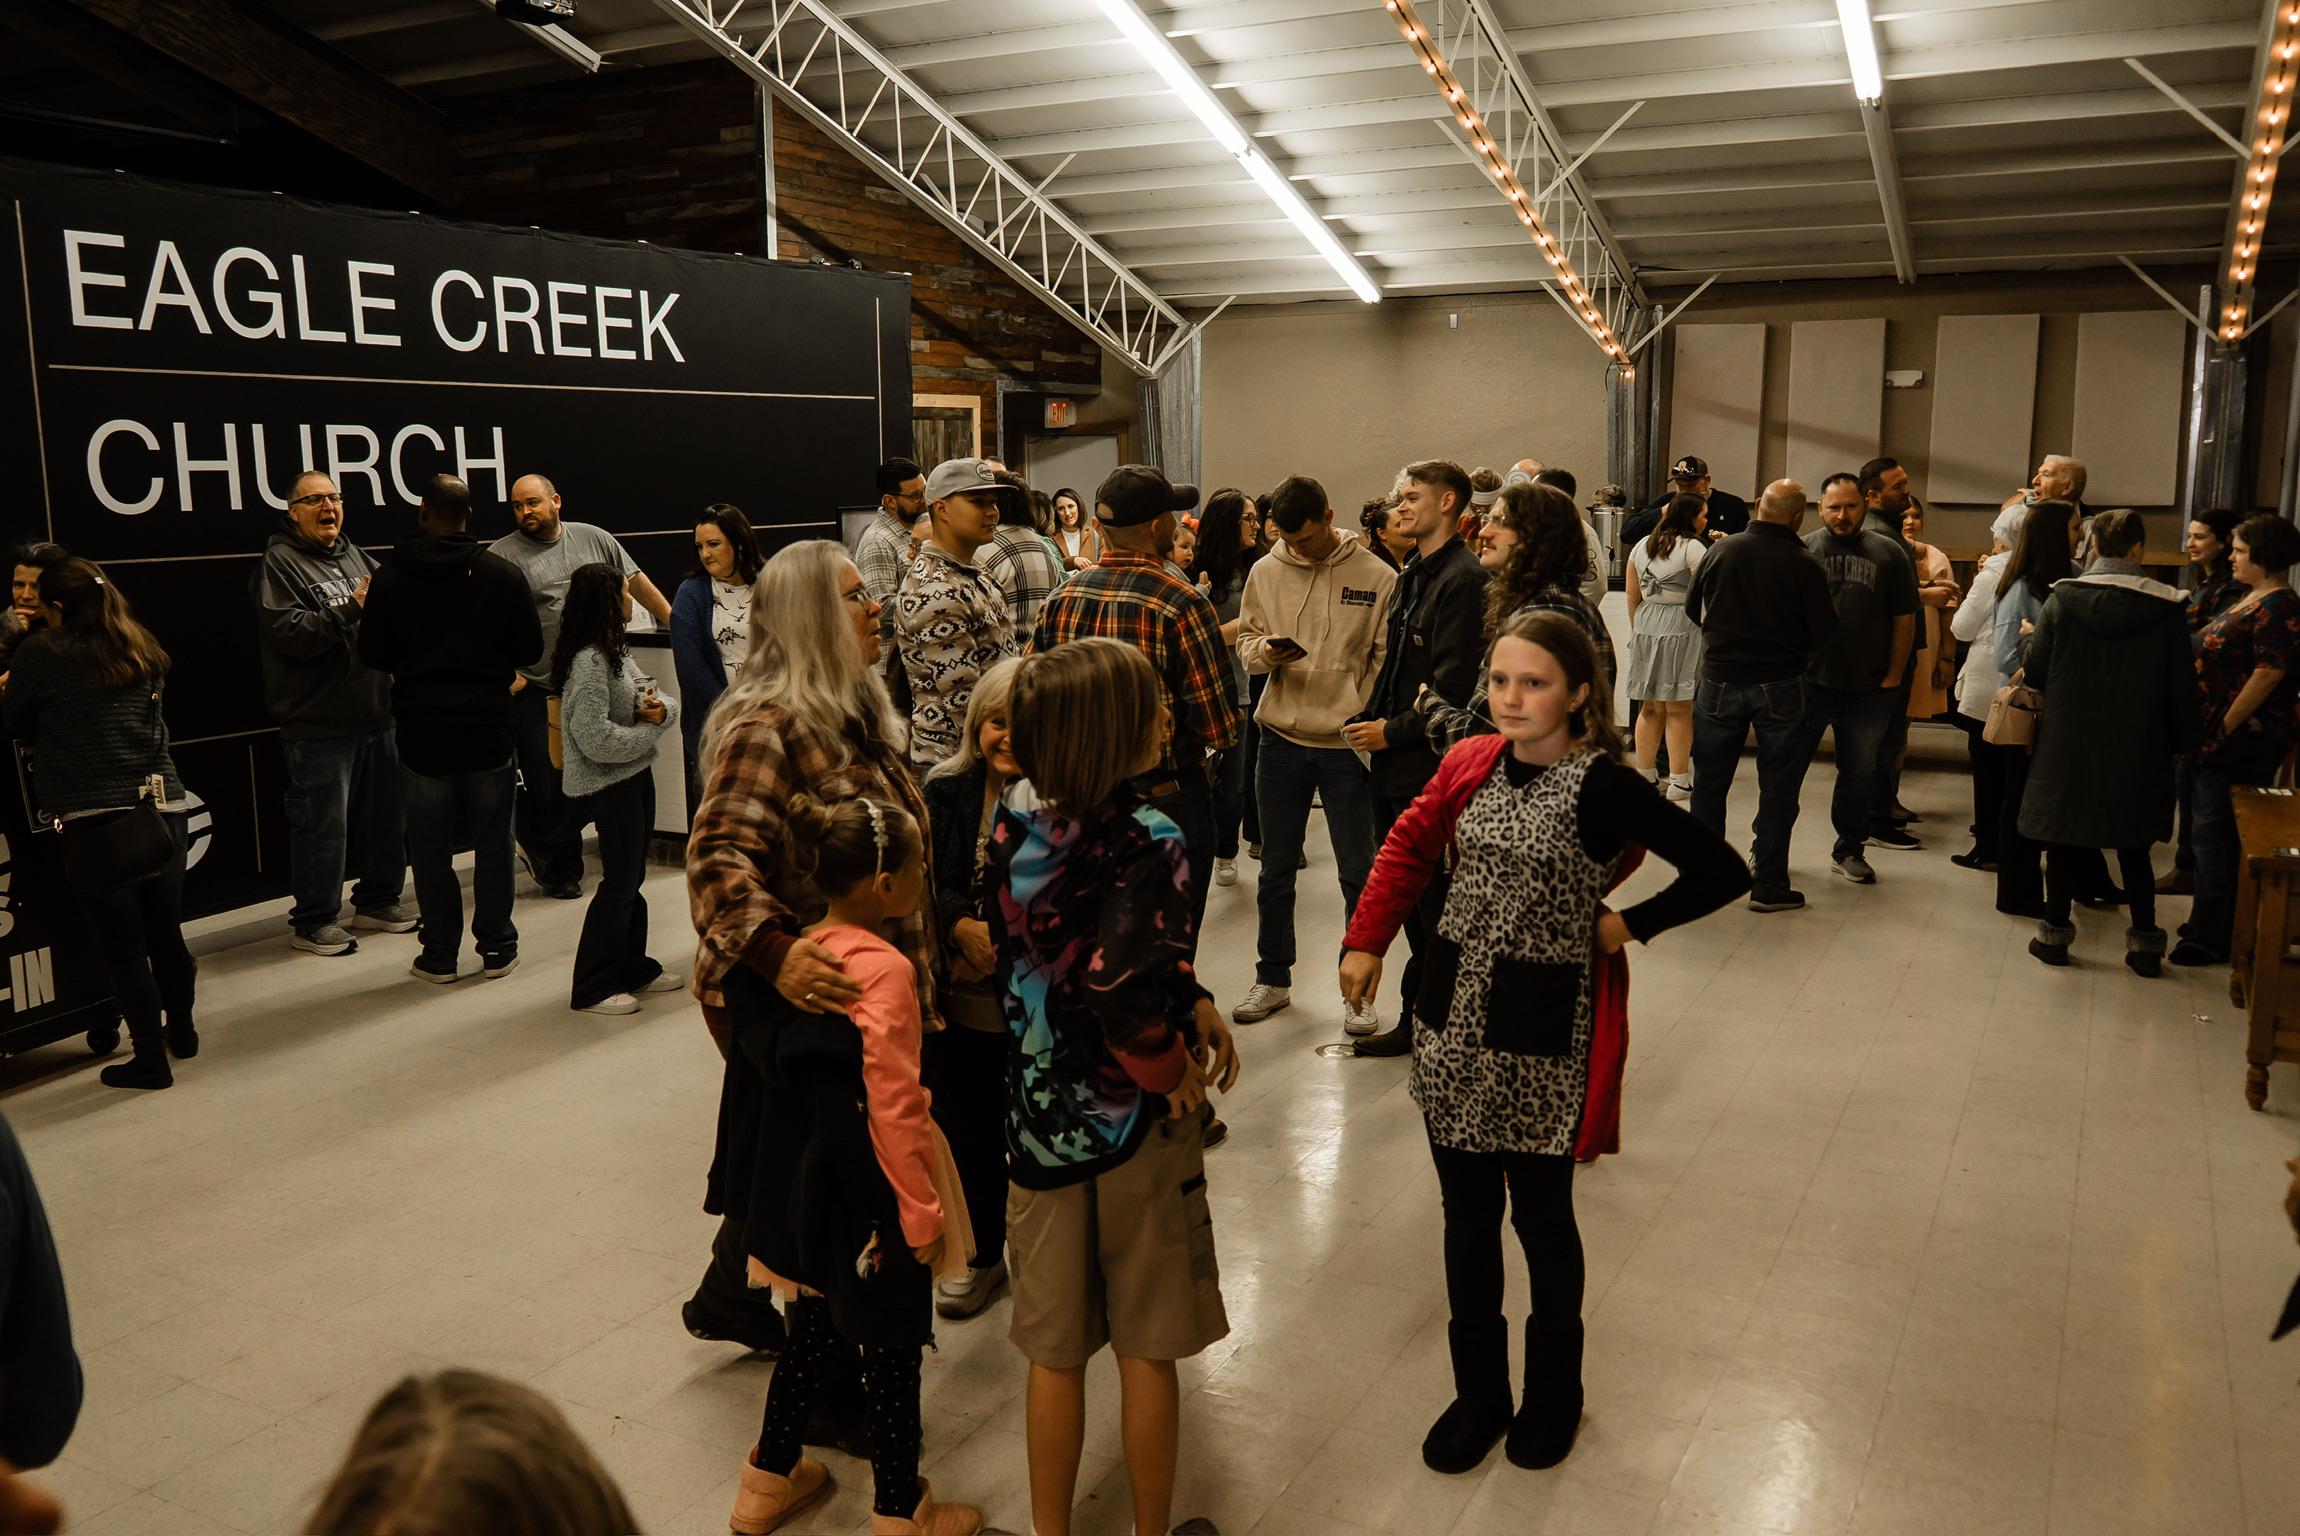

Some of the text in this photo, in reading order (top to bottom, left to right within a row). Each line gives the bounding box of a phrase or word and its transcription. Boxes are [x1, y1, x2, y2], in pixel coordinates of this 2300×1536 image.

[63, 229, 686, 363] EAGLE CREEK
[1051, 402, 1067, 425] EXIT
[86, 419, 508, 516] CHURCH
[1844, 554, 1878, 593] CREEK
